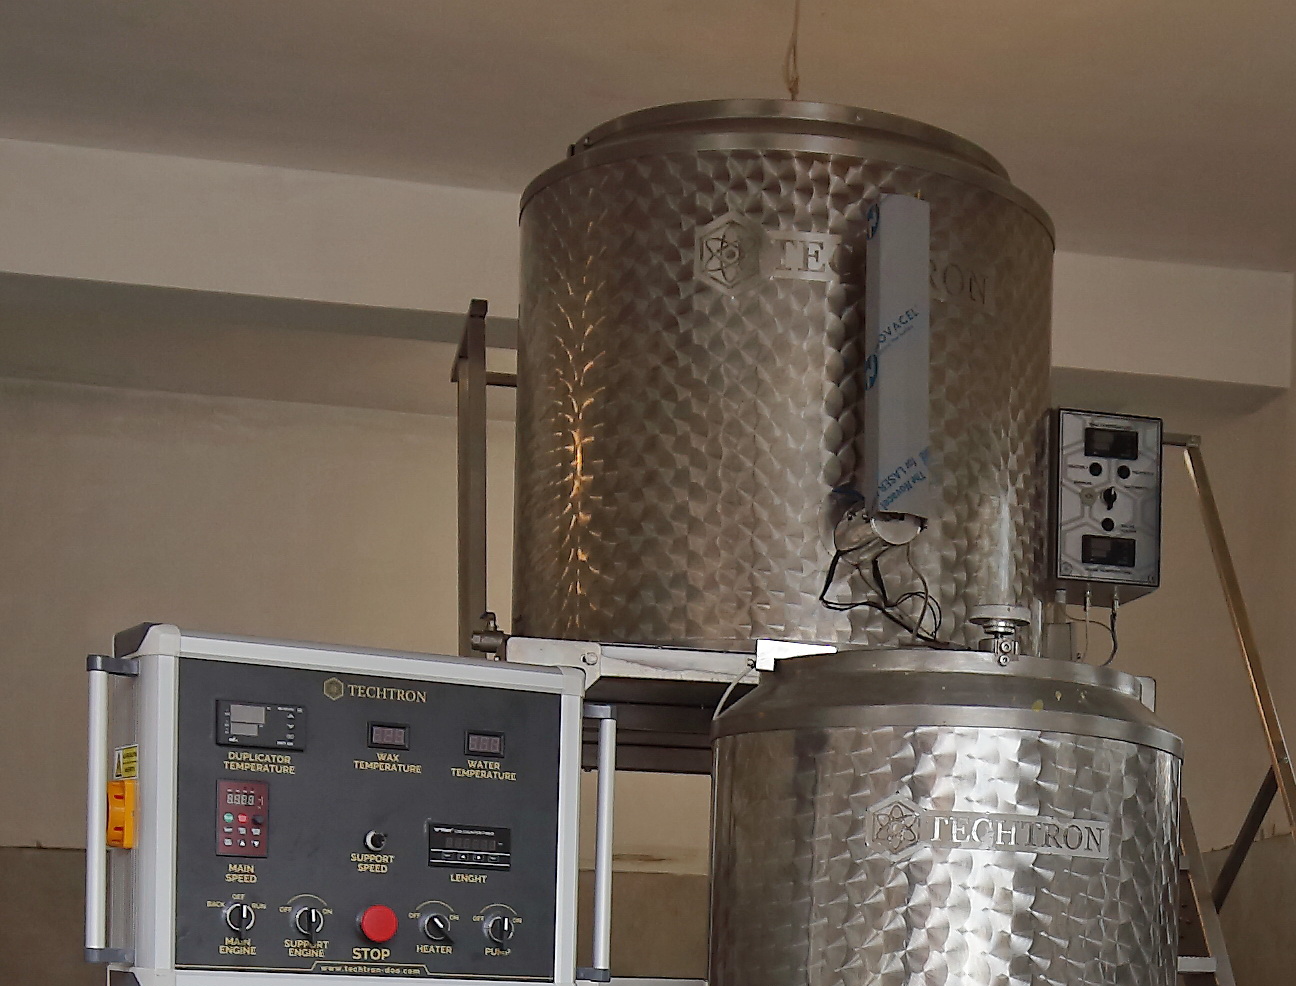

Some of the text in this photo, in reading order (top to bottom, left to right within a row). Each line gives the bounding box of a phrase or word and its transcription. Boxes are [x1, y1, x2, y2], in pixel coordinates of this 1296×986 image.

[347, 684, 427, 703] TECHTRON
[228, 751, 291, 764] DUPLICATOR
[376, 752, 400, 762] WAX
[223, 761, 296, 775] TEMPERATURE
[353, 760, 422, 774] TEMPERATURE
[467, 759, 501, 770] WATER
[451, 767, 517, 781] TEMPERATURE
[929, 814, 1105, 853] TECHTRON
[350, 853, 396, 864] SUPPORT
[228, 863, 255, 873] MAIN
[357, 864, 388, 873] SPEED
[224, 873, 258, 883] SPEED
[450, 873, 488, 884] LENGHT
[218, 945, 257, 956] ENGINE
[288, 949, 326, 958] ENGINE
[352, 947, 391, 961] STOP
[416, 944, 453, 955] HEATER
